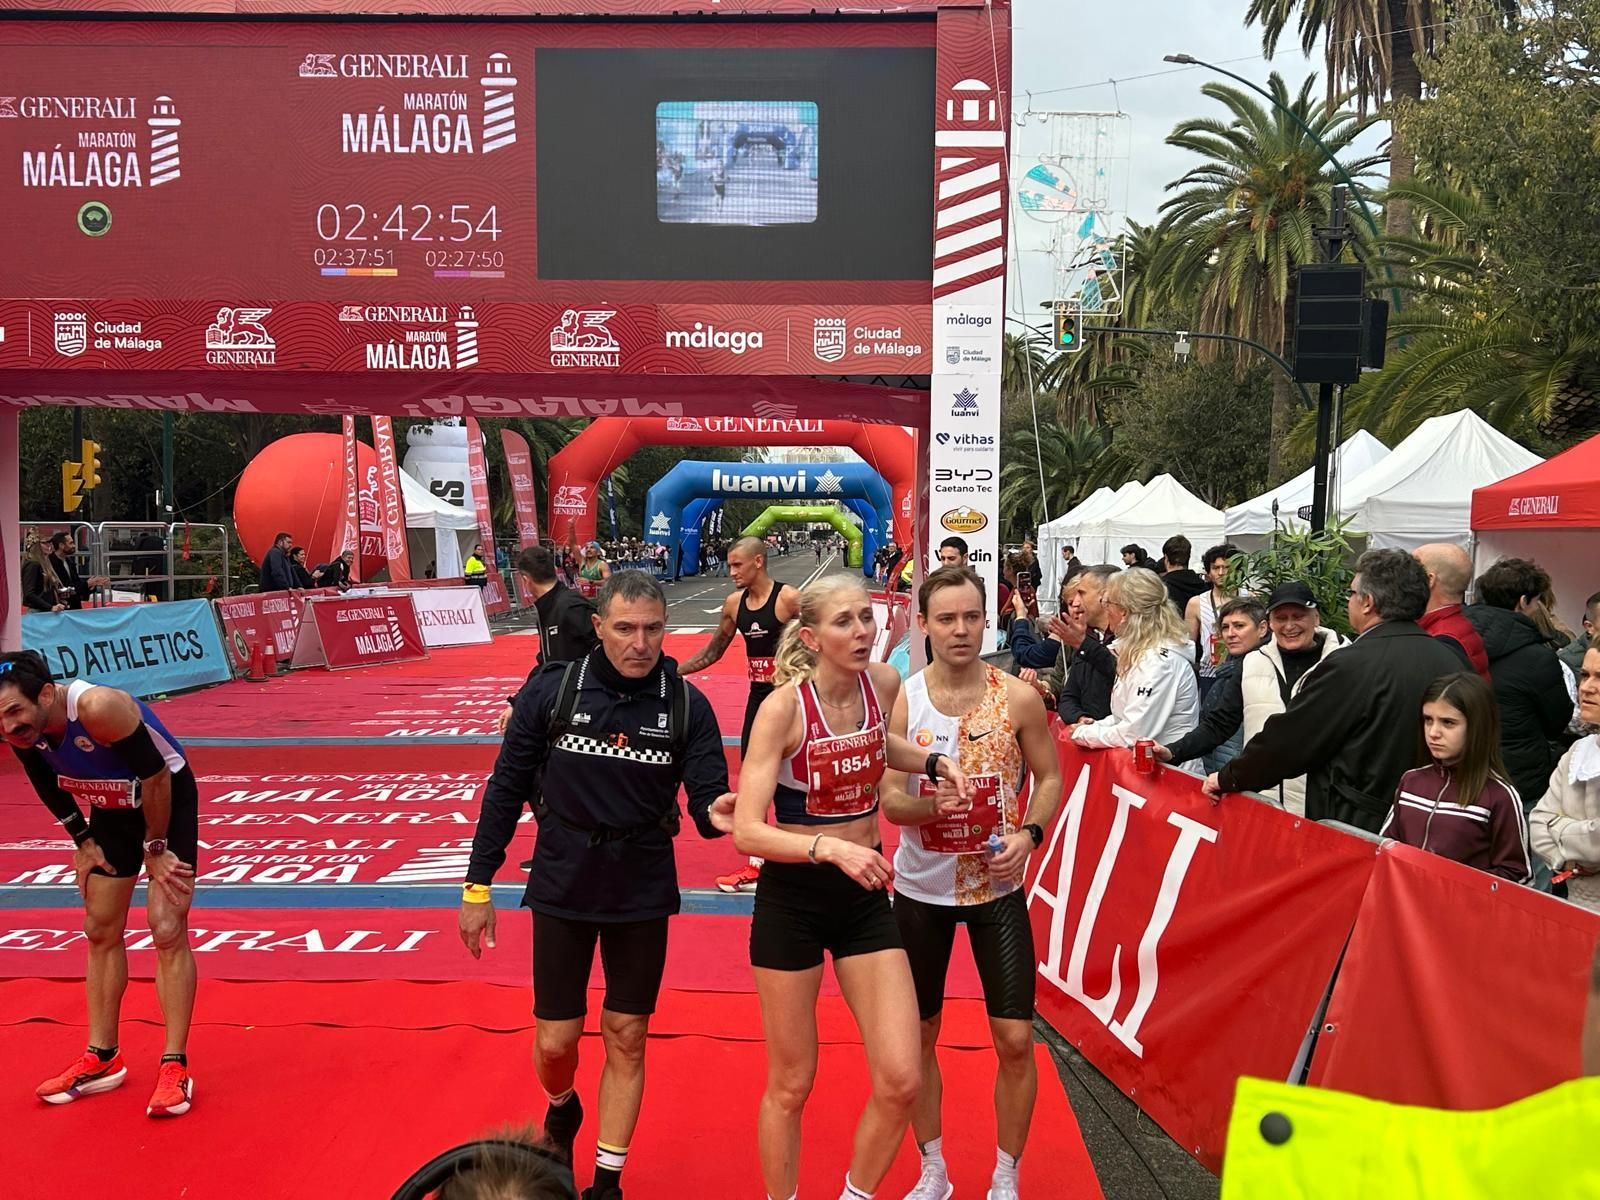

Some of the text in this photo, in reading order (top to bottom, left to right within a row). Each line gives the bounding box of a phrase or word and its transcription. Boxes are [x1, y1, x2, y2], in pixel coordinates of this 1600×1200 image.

[340, 54, 469, 78] GENERALI
[20, 97, 137, 119] GENERALI
[404, 91, 468, 110] MARATÓN
[342, 106, 474, 154] MÁLAGA
[78, 130, 136, 148] MARATÓN
[22, 143, 142, 187] MÁLAGA
[317, 203, 502, 242] 02:42:54
[314, 248, 395, 266] 02:37:51
[425, 250, 505, 267] 02:27:50
[364, 307, 448, 323] GENERALI
[94, 321, 142, 333] Ciudad
[853, 327, 902, 340] Ciudad
[94, 336, 162, 352] de Málaga
[405, 330, 447, 343] MARATÓN
[366, 339, 452, 369] MÁLAGA
[853, 341, 922, 356] de Málaga
[205, 351, 276, 365] GENERALI
[550, 354, 620, 367] GENERALI
[951, 409, 980, 417] luanvi
[704, 416, 825, 432] GENERALI
[953, 434, 994, 445] vithas
[712, 469, 806, 493] luanvi
[936, 470, 993, 481] BYD
[935, 485, 993, 493] Caetano Tec
[553, 507, 586, 516] GENERALI
[1520, 496, 1559, 515] GENERALI
[945, 516, 982, 524] Gourmet
[347, 608, 385, 620] GENERALI
[354, 631, 395, 655] MÁLAGA
[84, 629, 204, 676] ATHLETICS
[831, 731, 879, 753] GENERALI
[832, 753, 871, 776] 1854
[75, 783, 121, 791] GENERALI
[210, 787, 476, 803] MÁLAGA
[210, 853, 374, 864] MARATÓN
